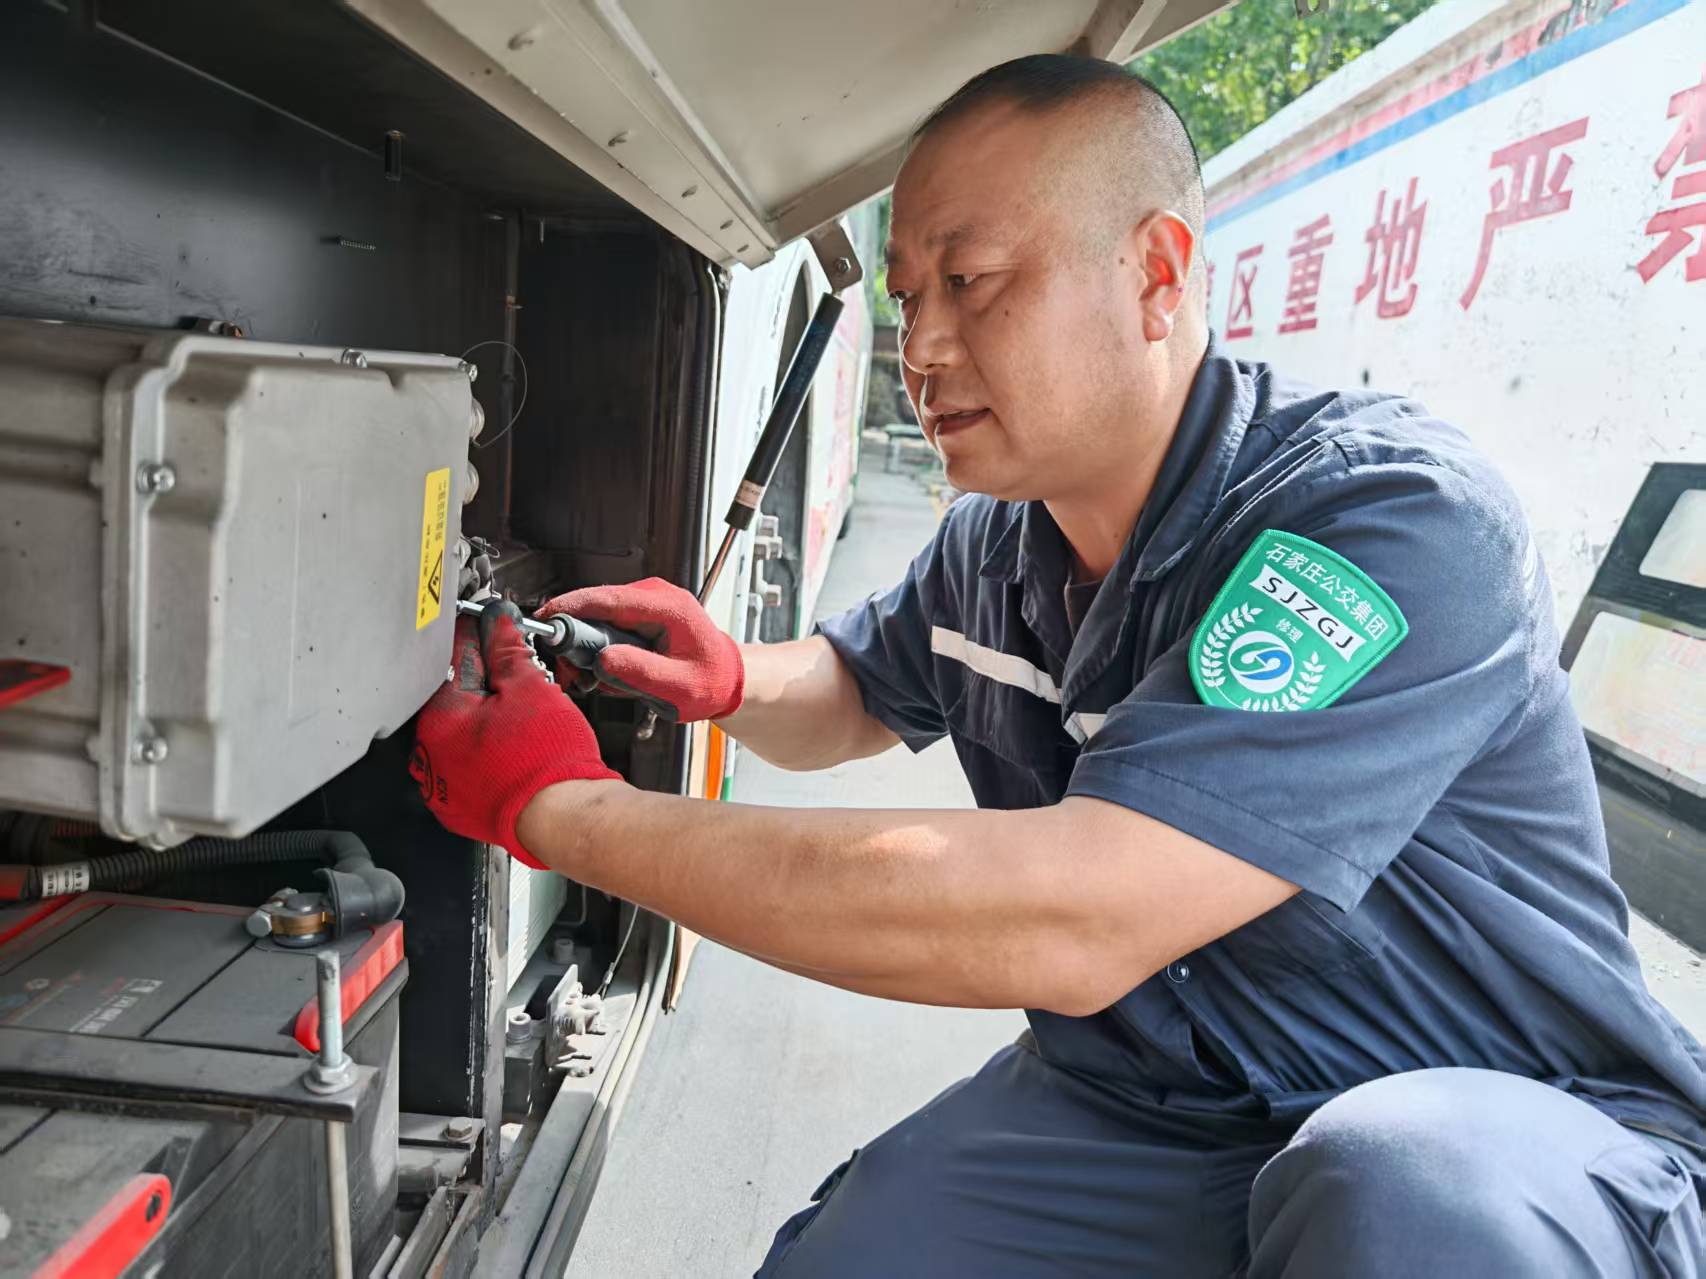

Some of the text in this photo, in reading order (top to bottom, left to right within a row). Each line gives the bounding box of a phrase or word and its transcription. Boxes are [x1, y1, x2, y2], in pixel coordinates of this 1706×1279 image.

[1206, 62, 1706, 340] 区重地严
[1262, 577, 1355, 649] SJZGJ
[1265, 542, 1389, 640] 石家庄公交集团
